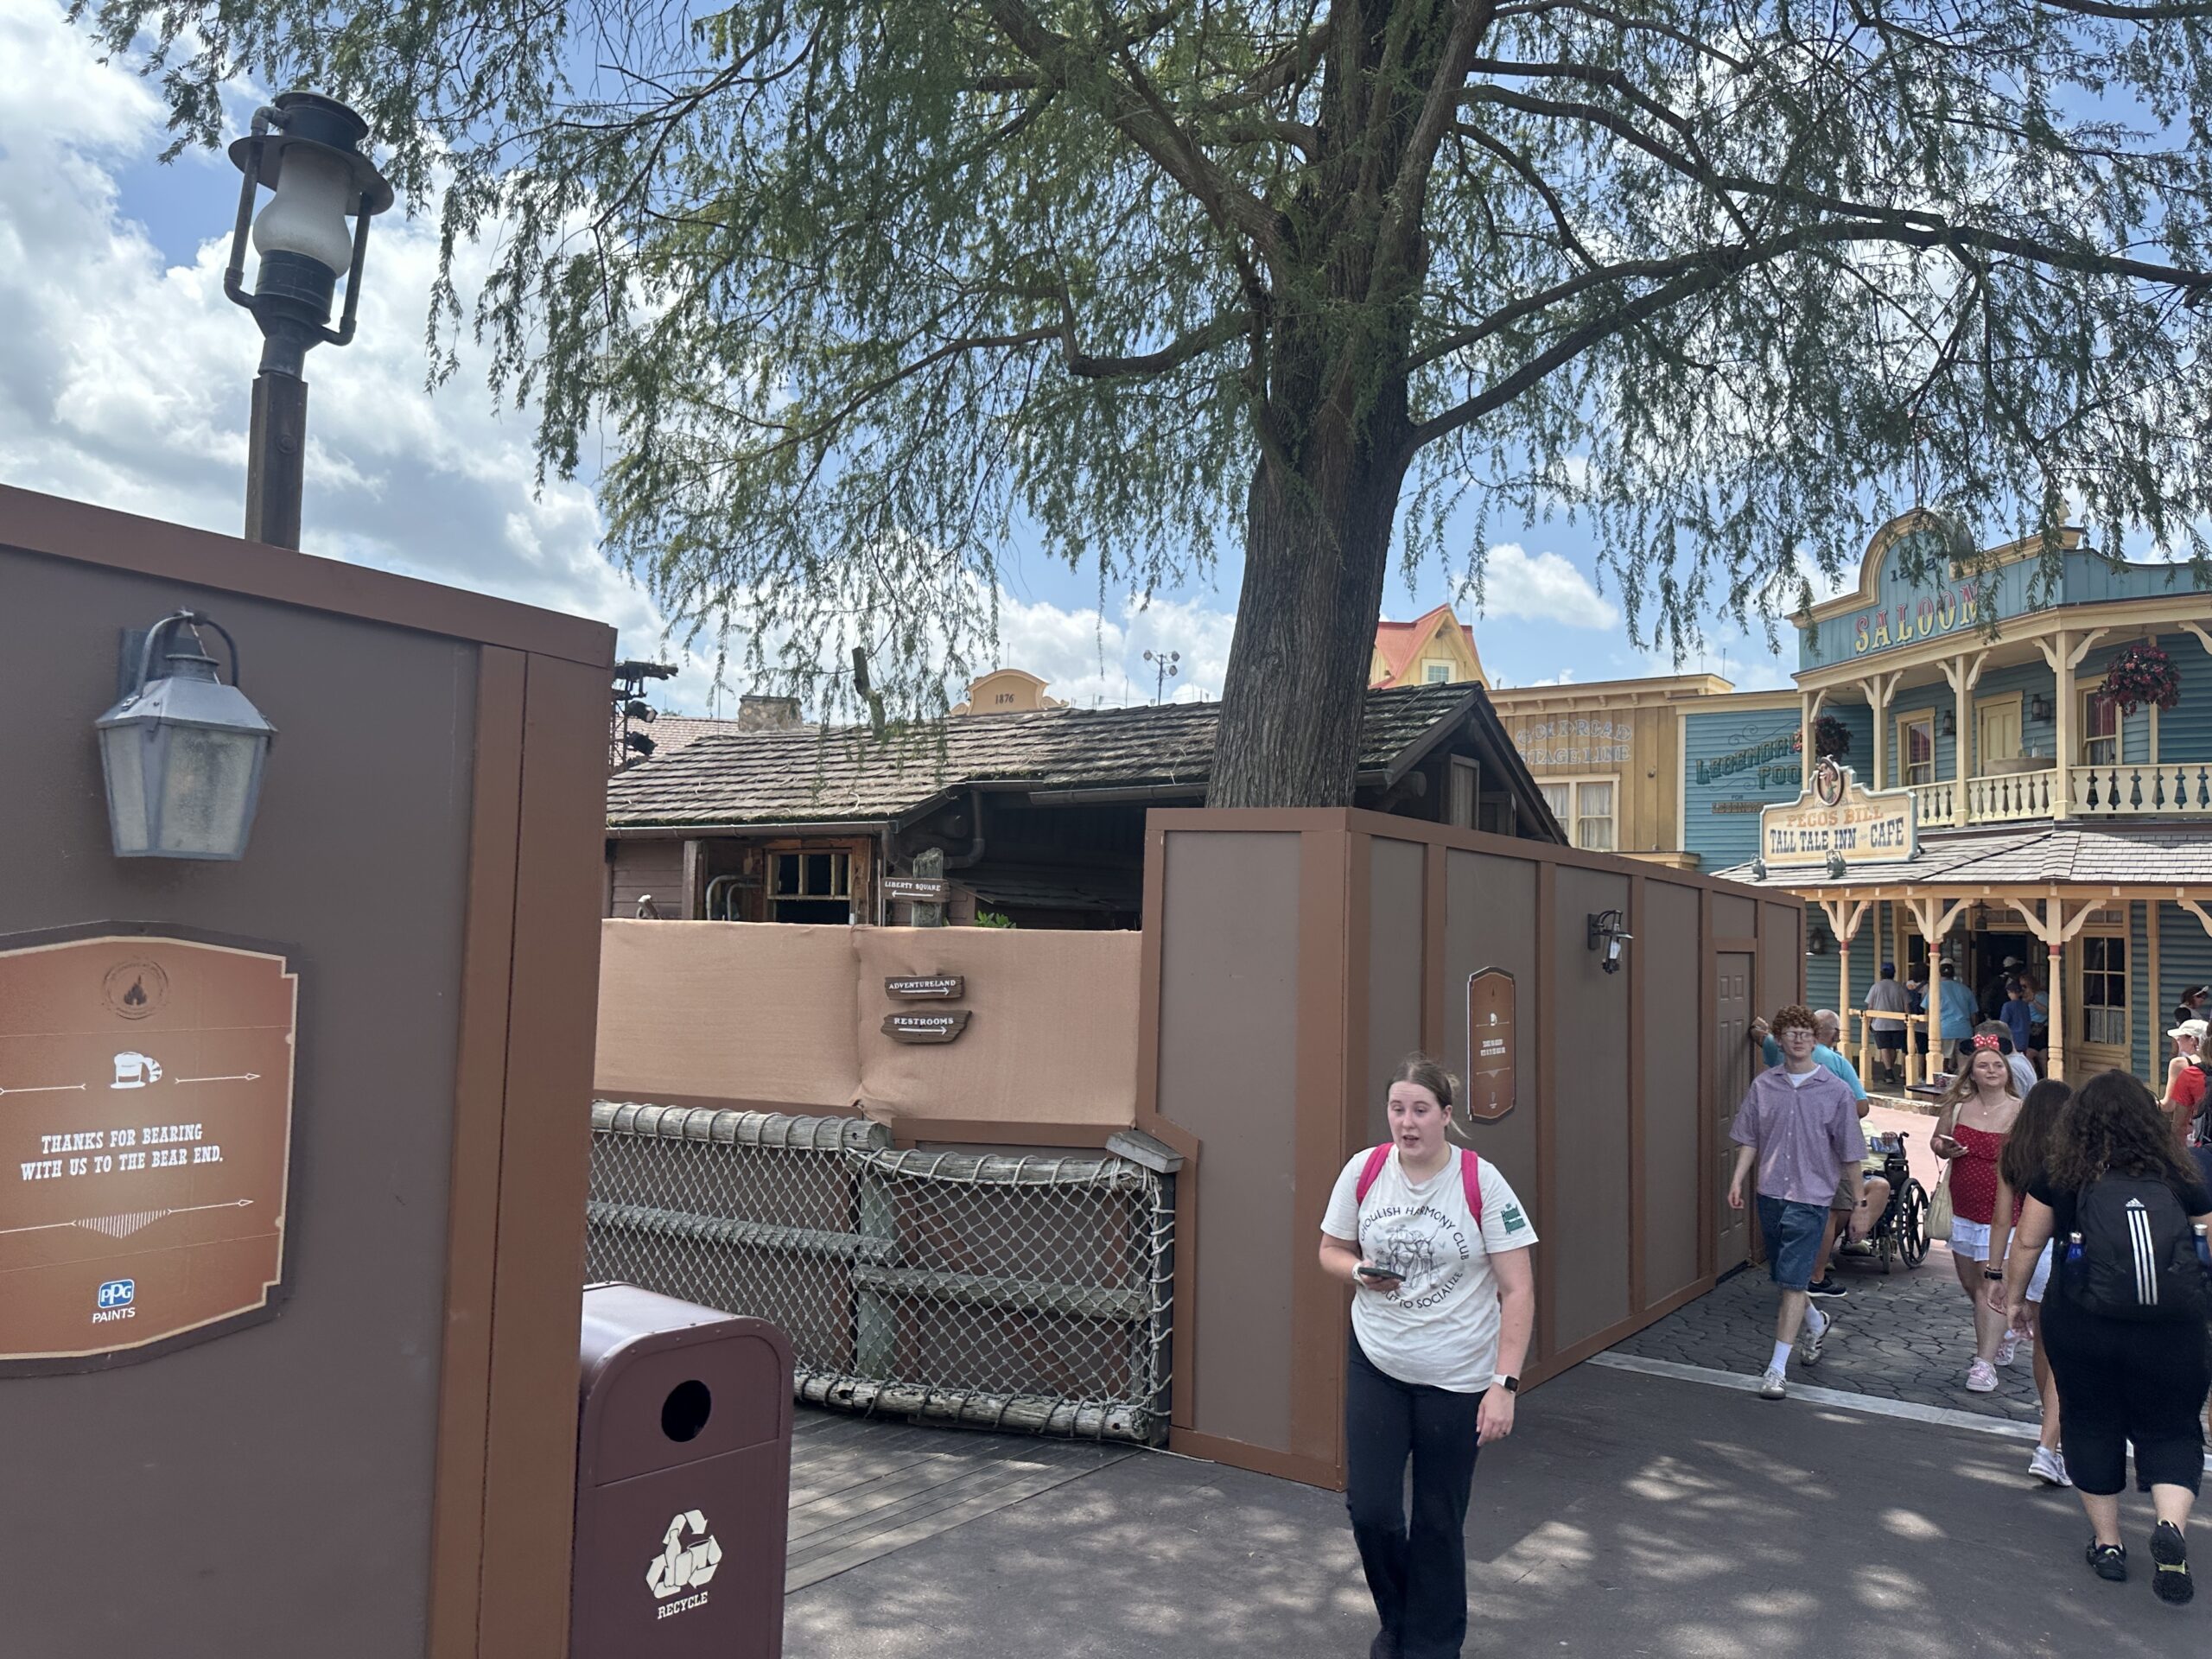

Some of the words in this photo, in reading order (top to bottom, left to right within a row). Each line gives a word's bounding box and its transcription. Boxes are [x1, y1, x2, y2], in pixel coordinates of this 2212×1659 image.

[1854, 582, 1980, 654] SALOON
[995, 694, 1014, 705] 1876
[1516, 719, 1574, 746] GOLD
[1575, 719, 1632, 741] ROAD
[1518, 747, 1580, 766] STAGE
[1583, 745, 1631, 764] LINE
[1758, 765, 1802, 791] FOO
[1844, 805, 1884, 824] BILL
[1770, 829, 1796, 854] TALL
[1799, 828, 1828, 851] TALE
[1834, 827, 1857, 850] INN
[884, 880, 912, 890] LIBERTY
[915, 882, 942, 892] SQUARE
[888, 980, 957, 989] ADVENTURELAND
[893, 1017, 954, 1026] RESTROOMS
[41, 1133, 104, 1154] THANKS
[110, 1129, 136, 1148] FOR
[142, 1123, 203, 1145] BEARING
[21, 1160, 62, 1180] WITH
[69, 1157, 87, 1176] US
[94, 1154, 112, 1173] TO
[118, 1153, 145, 1171] THE
[151, 1149, 188, 1169] BEAR
[194, 1145, 223, 1164] END.
[1360, 1207, 1401, 1242] GHOULISH
[1405, 1205, 1455, 1230] HARMONY
[1452, 1231, 1470, 1261] CLUB
[100, 1283, 132, 1305] PPG
[1400, 1299, 1414, 1309] TO
[1417, 1271, 1463, 1309] SOCIALIZE
[92, 1307, 136, 1324] PAINTS
[658, 1592, 709, 1620] RECYCLE
